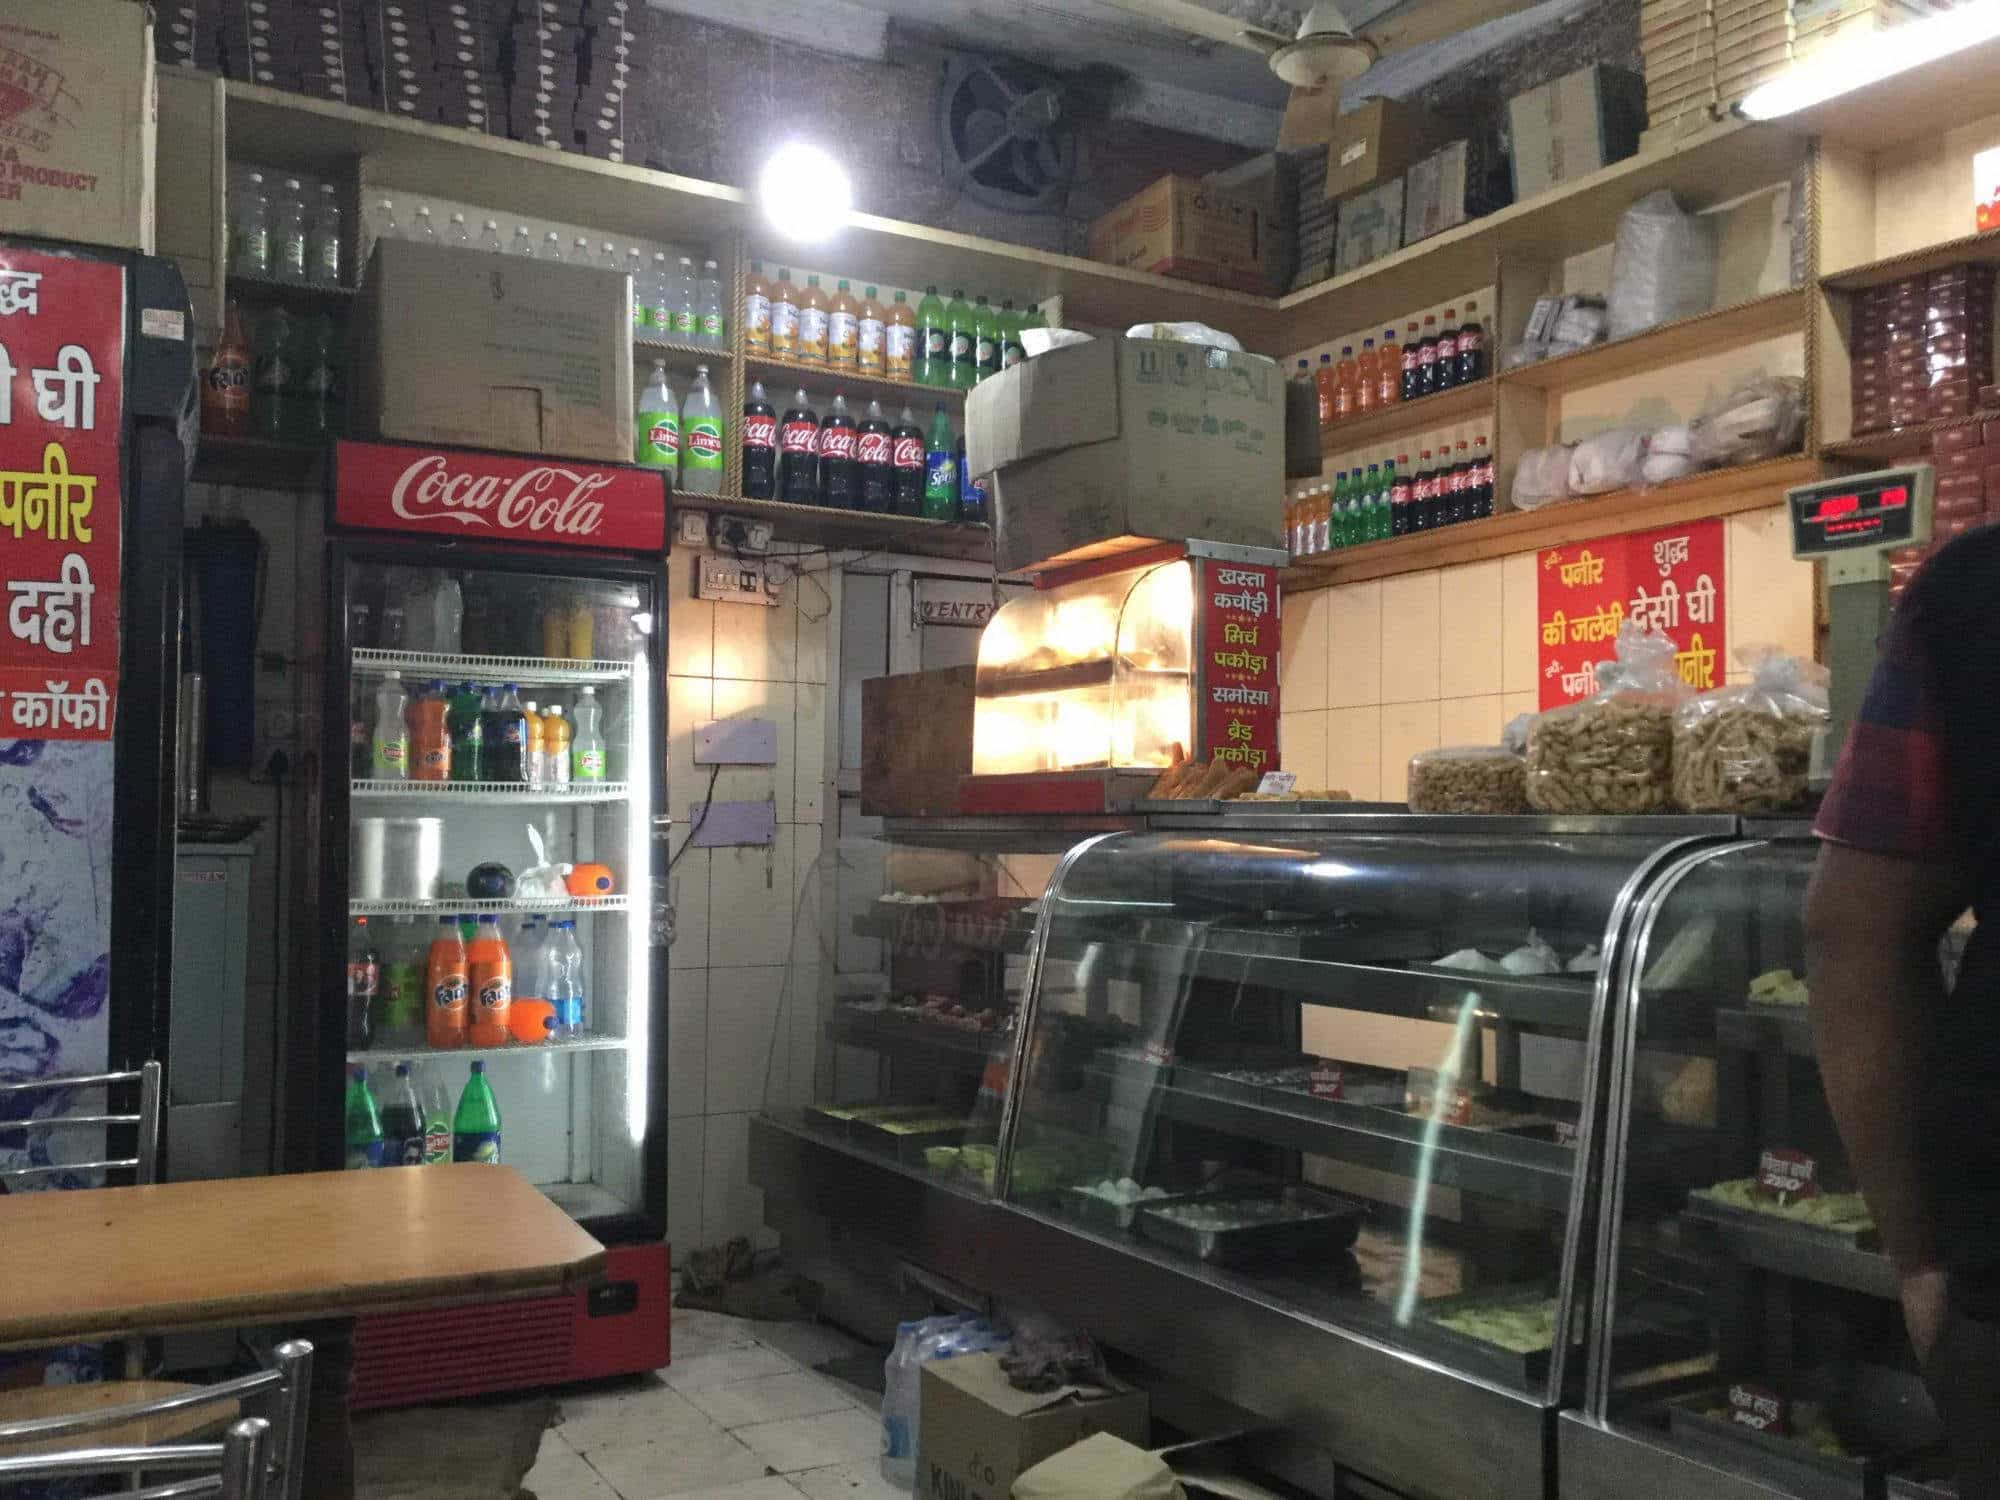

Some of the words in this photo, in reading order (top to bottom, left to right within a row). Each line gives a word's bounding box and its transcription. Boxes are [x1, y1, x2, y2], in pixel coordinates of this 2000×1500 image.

[31, 344, 101, 430] घी
[391, 455, 616, 536] Coca-Cola
[1560, 549, 1604, 588] पनीर
[7, 552, 95, 653] दही
[1685, 573, 1716, 625] घी
[1542, 610, 1567, 646] की
[11, 677, 110, 731] कॉफी
[1212, 683, 1270, 706] समोसा
[1561, 661, 1600, 697] पनी
